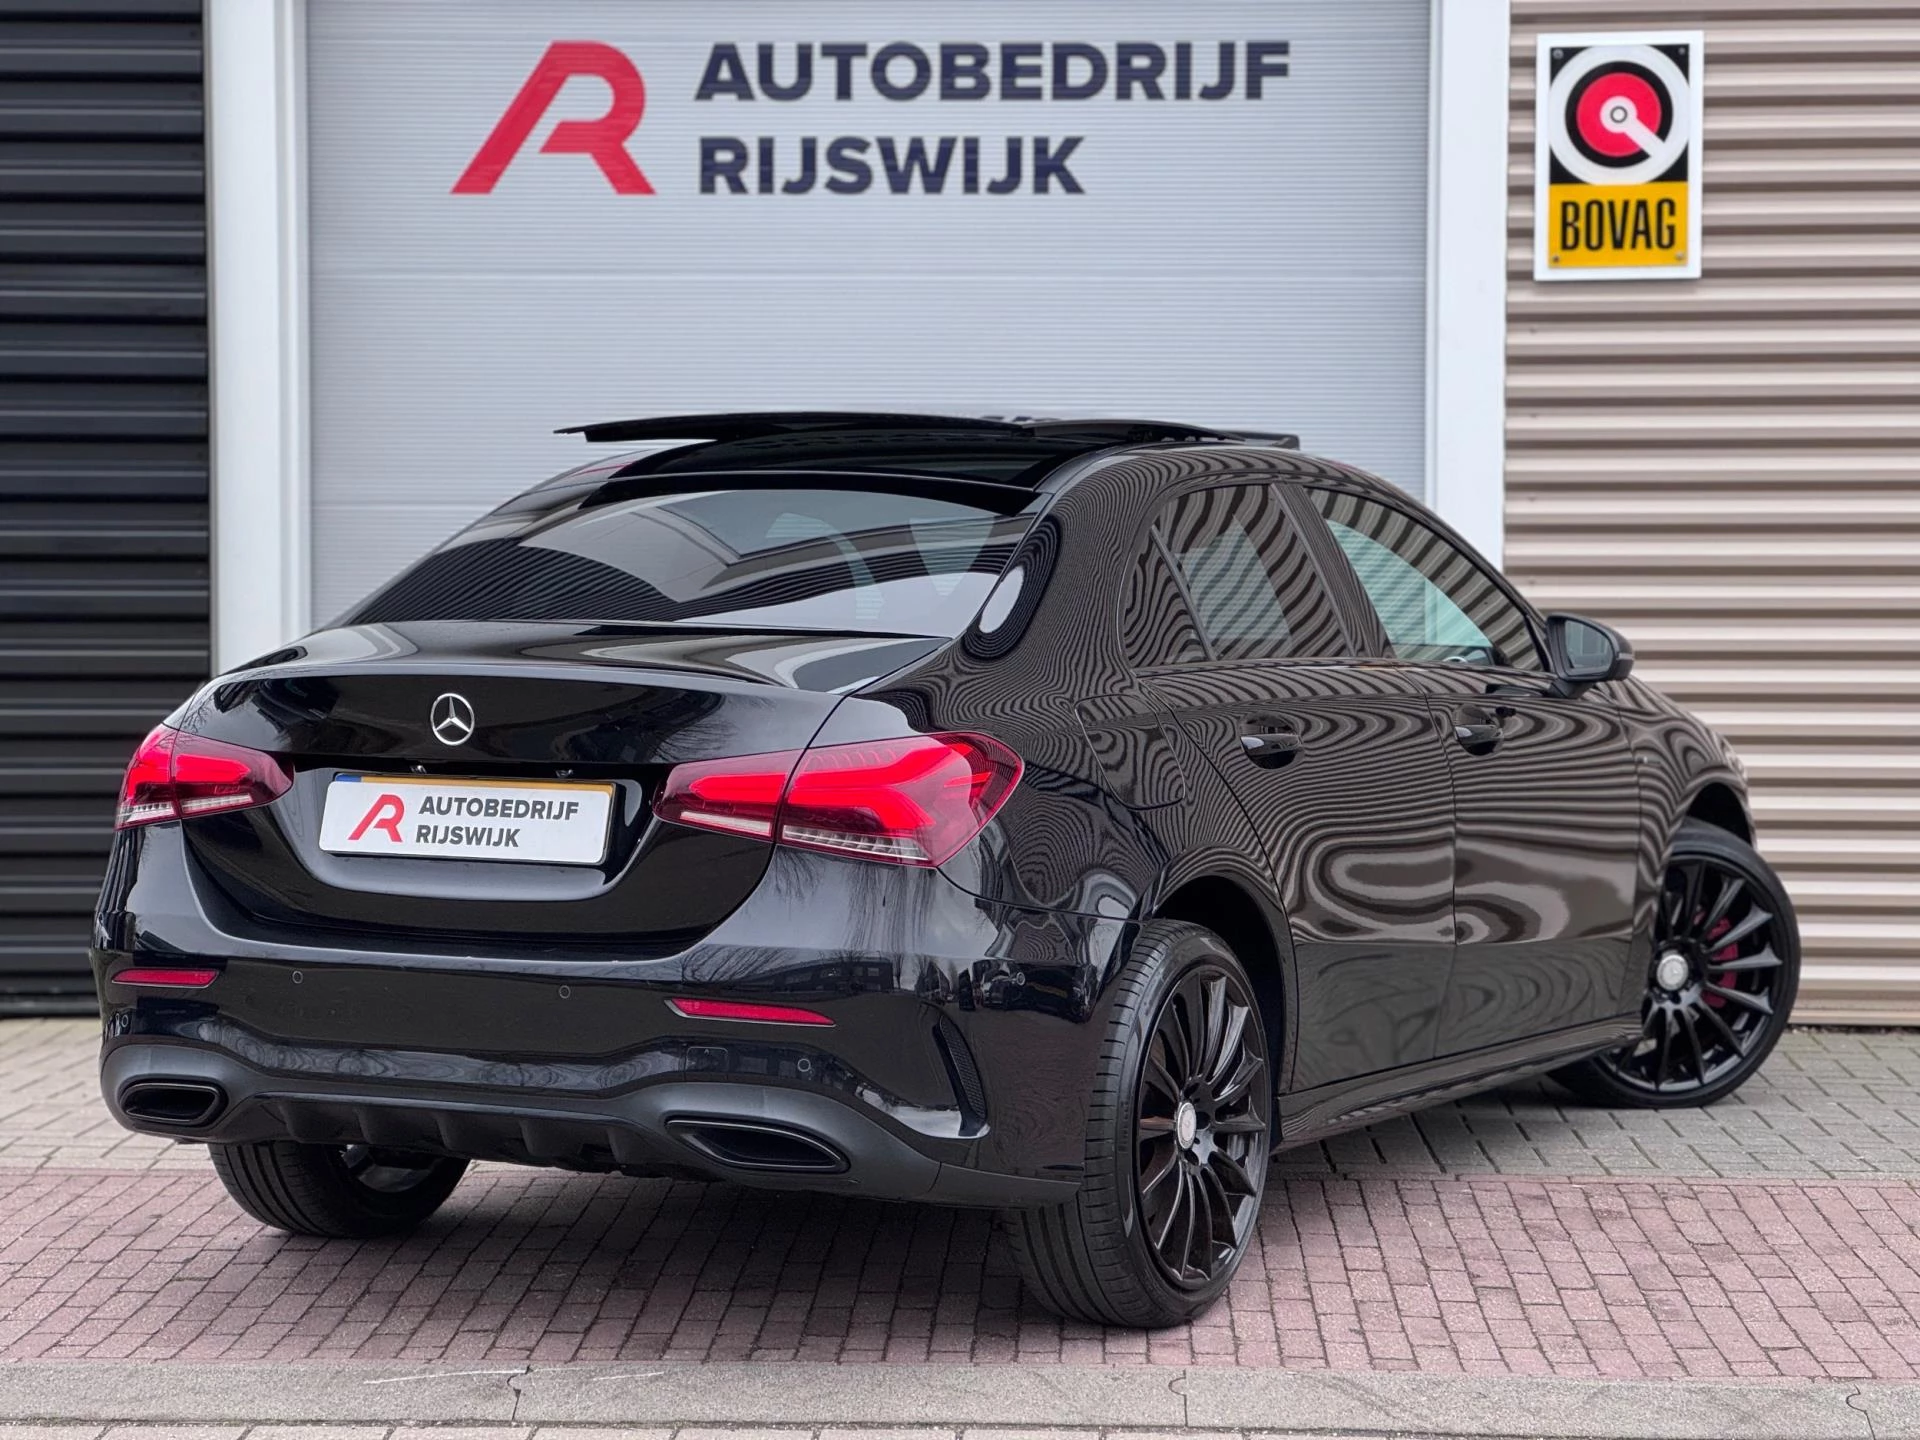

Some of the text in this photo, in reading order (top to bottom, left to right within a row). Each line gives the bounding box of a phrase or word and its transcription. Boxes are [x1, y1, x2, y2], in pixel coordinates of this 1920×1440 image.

[694, 40, 1292, 102] AUTOBEDRIJF
[699, 135, 1086, 196] RIJSWIJK
[1560, 197, 1677, 252] BOVAG
[415, 824, 521, 848] RIJSWIJK
[418, 796, 579, 821] AUTOBEDRIJF
